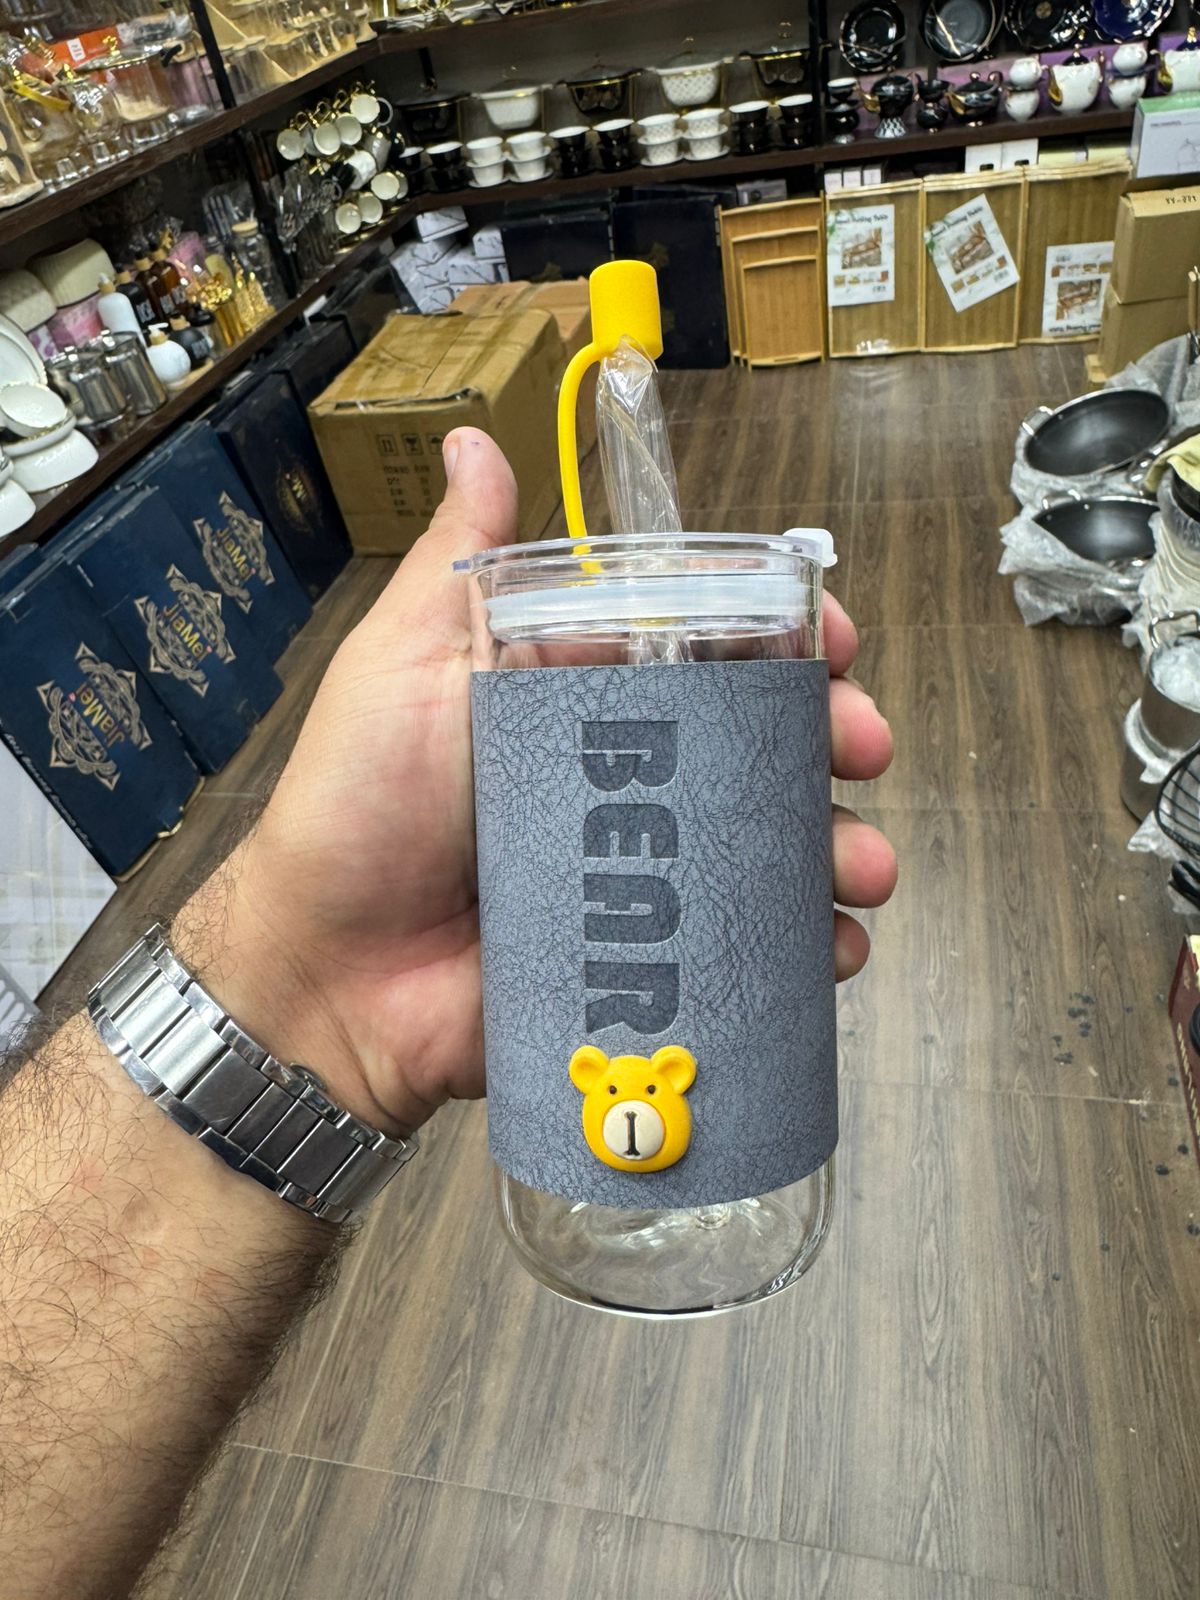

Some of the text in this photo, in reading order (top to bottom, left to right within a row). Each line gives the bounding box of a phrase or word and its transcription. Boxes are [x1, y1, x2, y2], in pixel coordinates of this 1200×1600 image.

[215, 527, 257, 582] JiaMei
[162, 603, 213, 661] JiaMei
[68, 683, 125, 748] JiaMei
[582, 720, 682, 1036] BEAR
